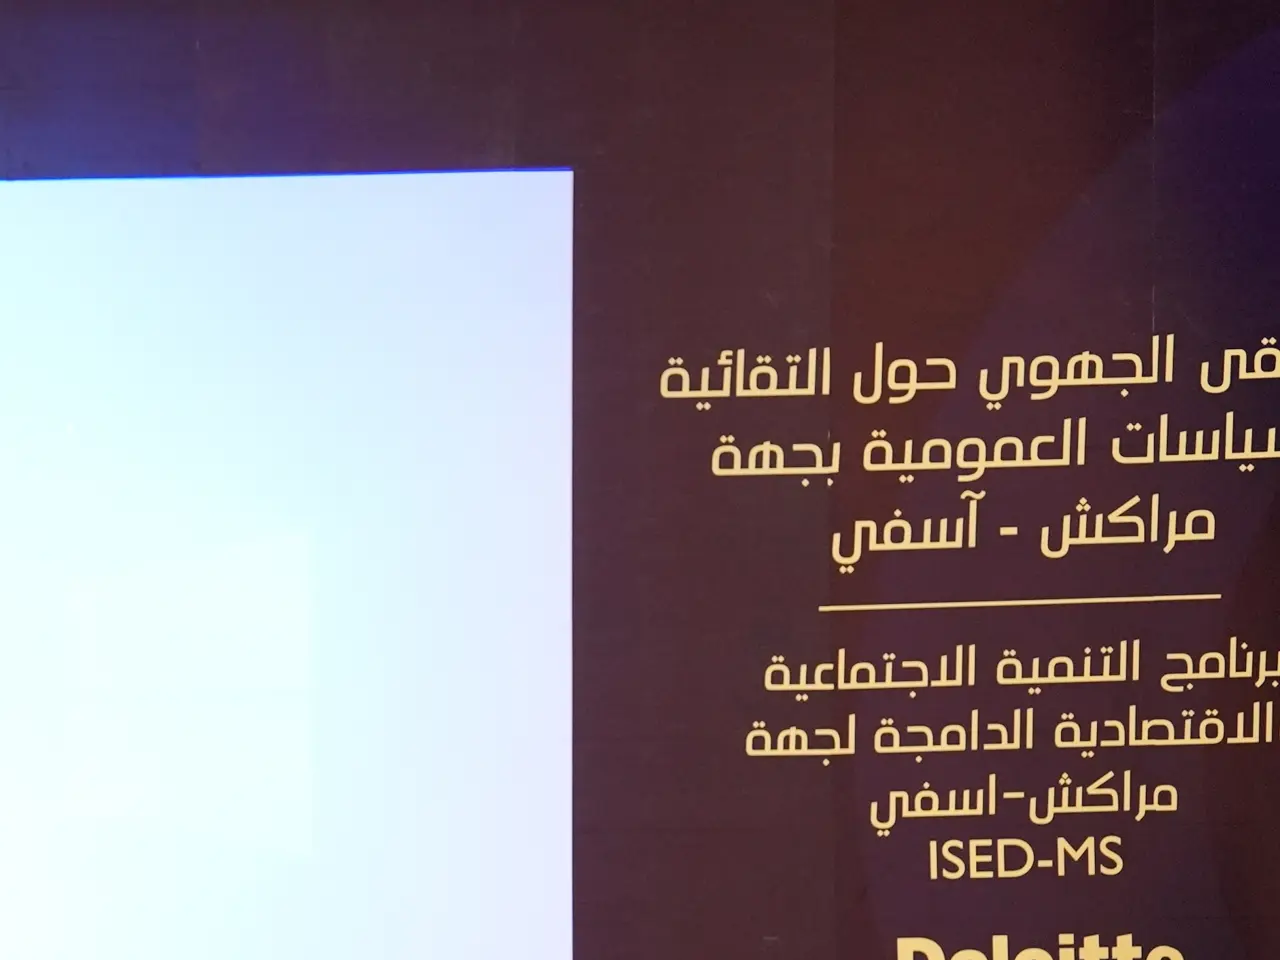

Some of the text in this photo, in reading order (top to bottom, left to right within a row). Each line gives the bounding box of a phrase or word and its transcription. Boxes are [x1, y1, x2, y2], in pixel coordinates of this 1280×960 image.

[660, 347, 830, 410] التقائية
[853, 342, 956, 404] حول
[979, 334, 1174, 410] الجهوي
[712, 435, 840, 487] بجهة
[863, 417, 1086, 483] العمومية
[832, 490, 986, 574] آسفي
[1041, 494, 1215, 558] مراكش
[765, 644, 975, 701] الاجتماعية
[997, 639, 1139, 694] التنمية
[746, 714, 855, 766] لجهة
[874, 708, 1033, 763] الدامجة
[930, 836, 1123, 879] ISED-MS
